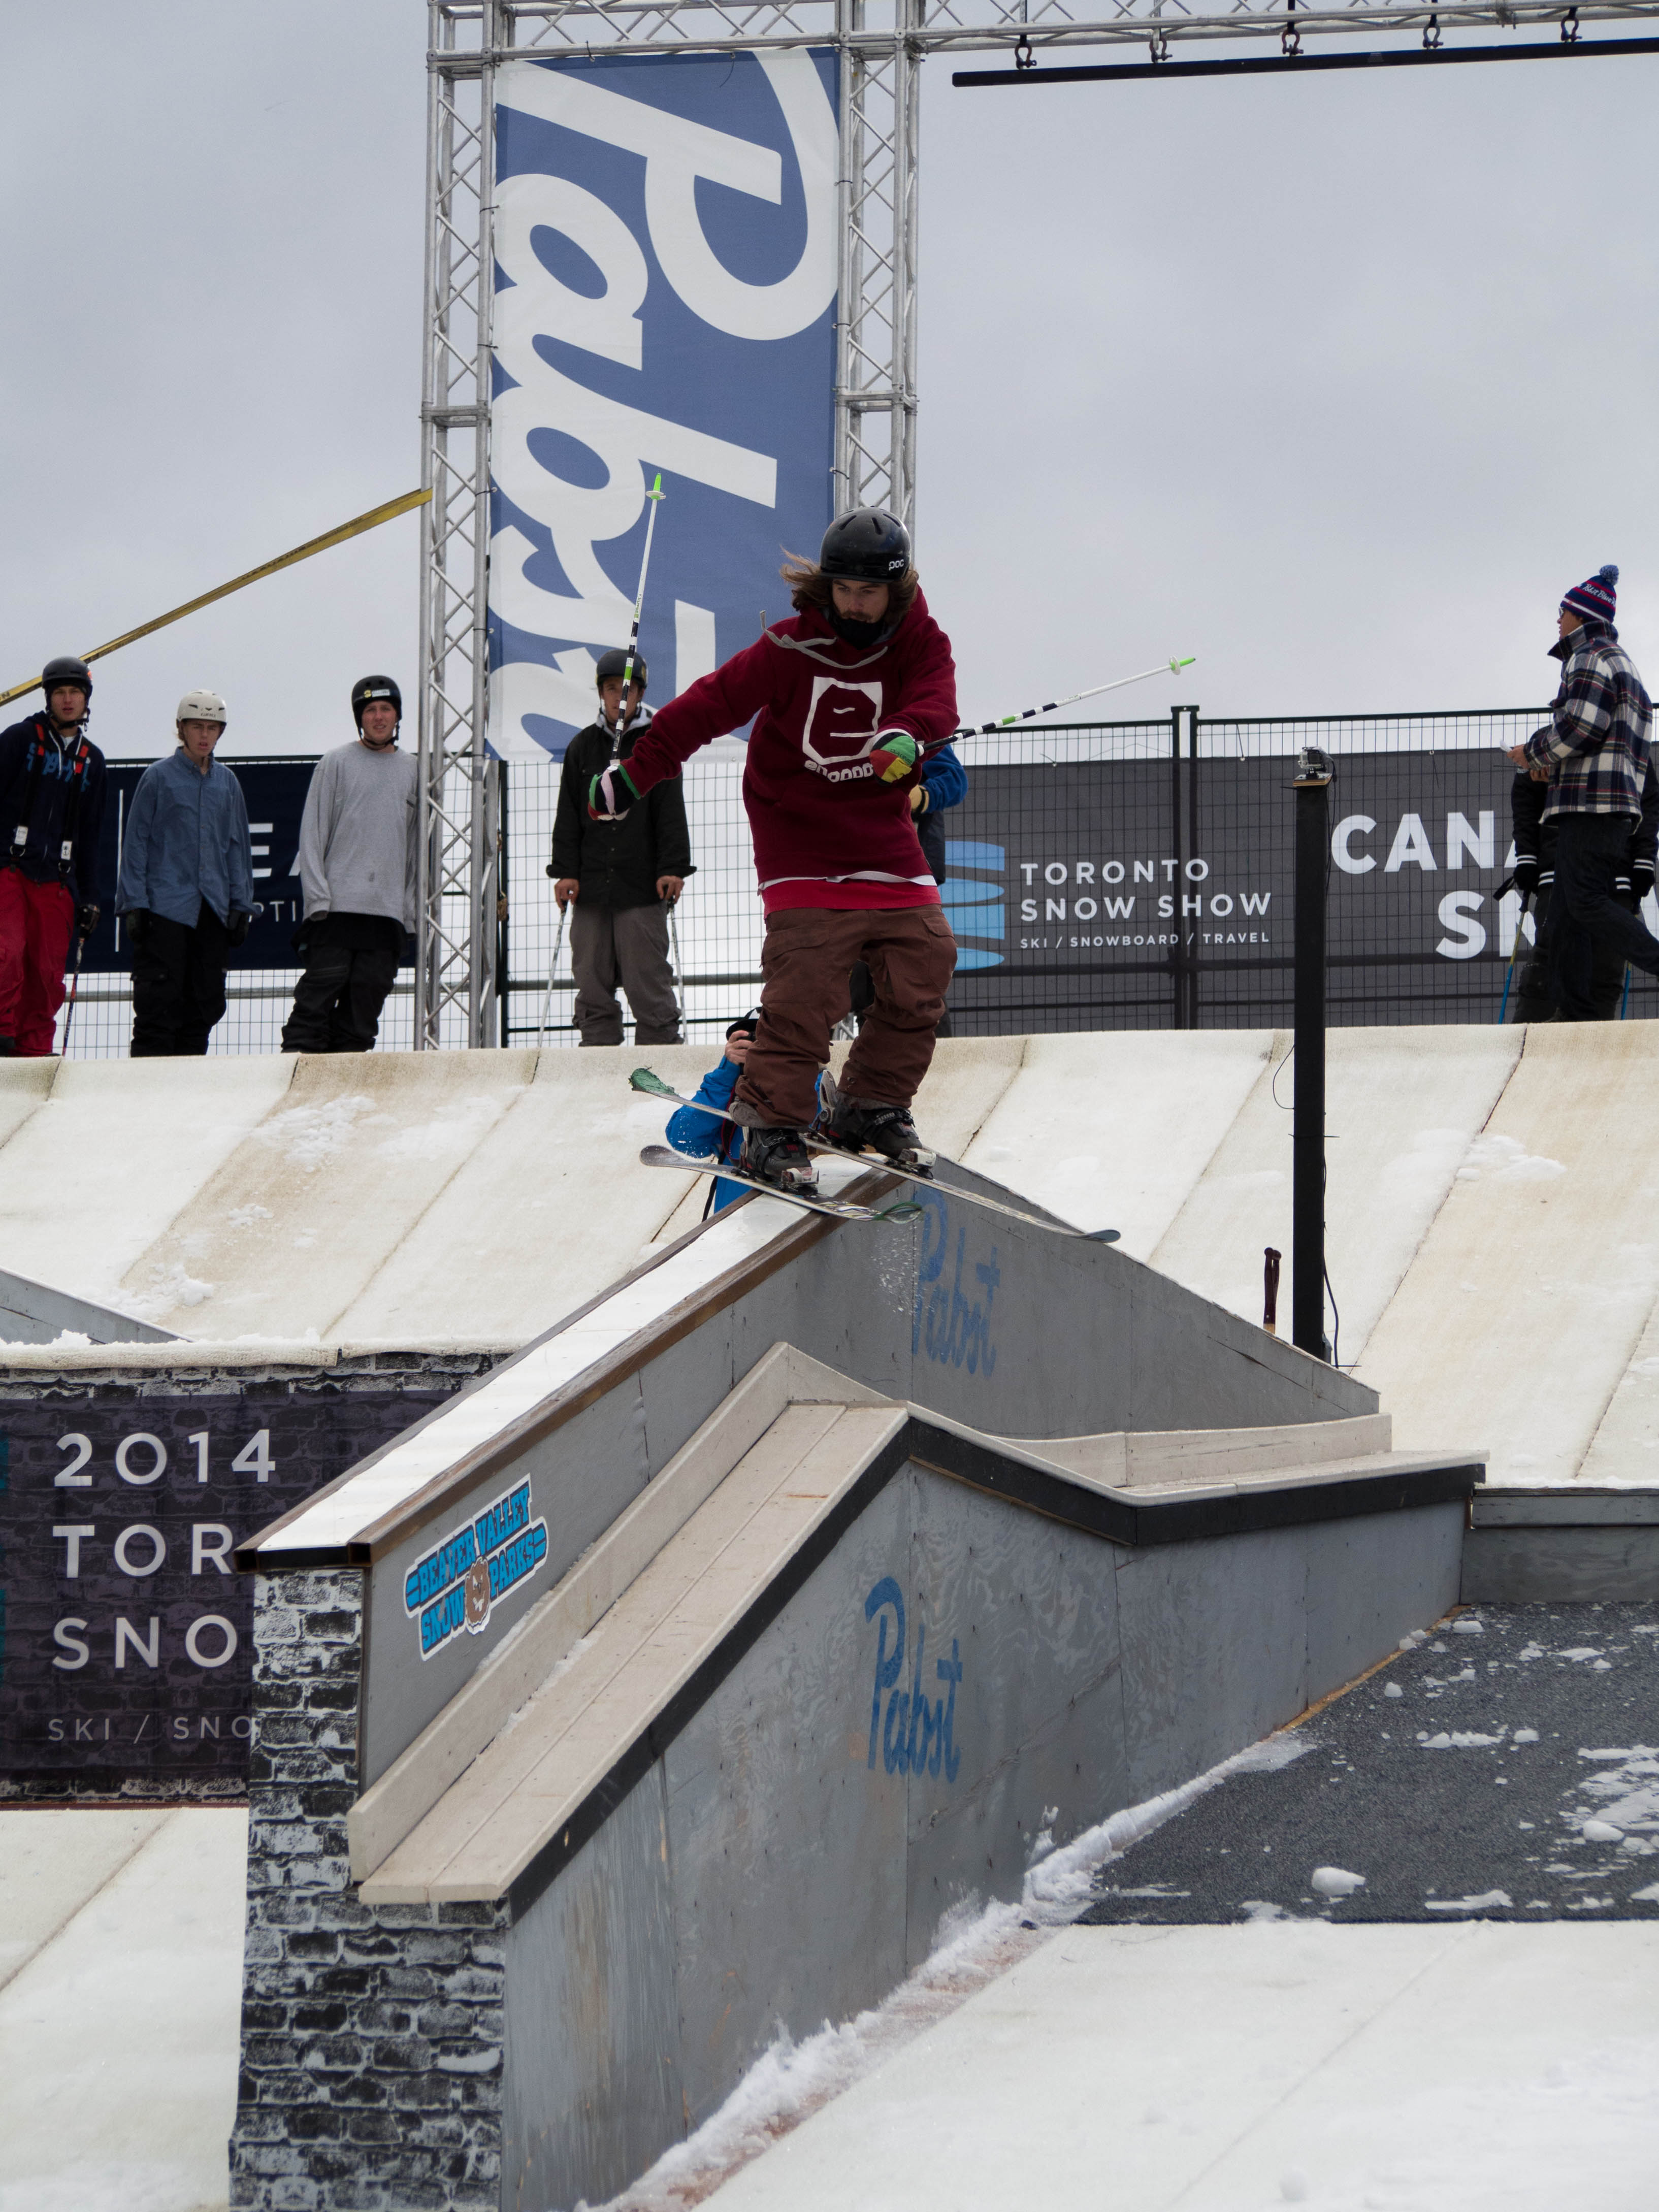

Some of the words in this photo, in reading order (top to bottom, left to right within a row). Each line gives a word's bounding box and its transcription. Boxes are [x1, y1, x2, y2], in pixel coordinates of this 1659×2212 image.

[1331, 811, 1516, 874] CAN
[1021, 859, 1209, 885] TORONTO
[1021, 897, 1135, 921] SNOW
[1158, 893, 1271, 917] SHOW
[1020, 938, 1047, 949] SKI
[1070, 934, 1178, 947] SNOWBOARD
[1203, 932, 1269, 944] TRAVEL
[54, 1429, 275, 1486] 2014
[53, 1524, 233, 1578] TOR
[418, 1530, 476, 1602] BEAVER
[476, 1486, 529, 1555] VALLEY
[422, 1587, 465, 1650] SNOW
[489, 1533, 534, 1598] PARKS
[52, 1615, 237, 1670] SNO
[865, 1576, 963, 1783] Pabst
[48, 1718, 109, 1741] SKI
